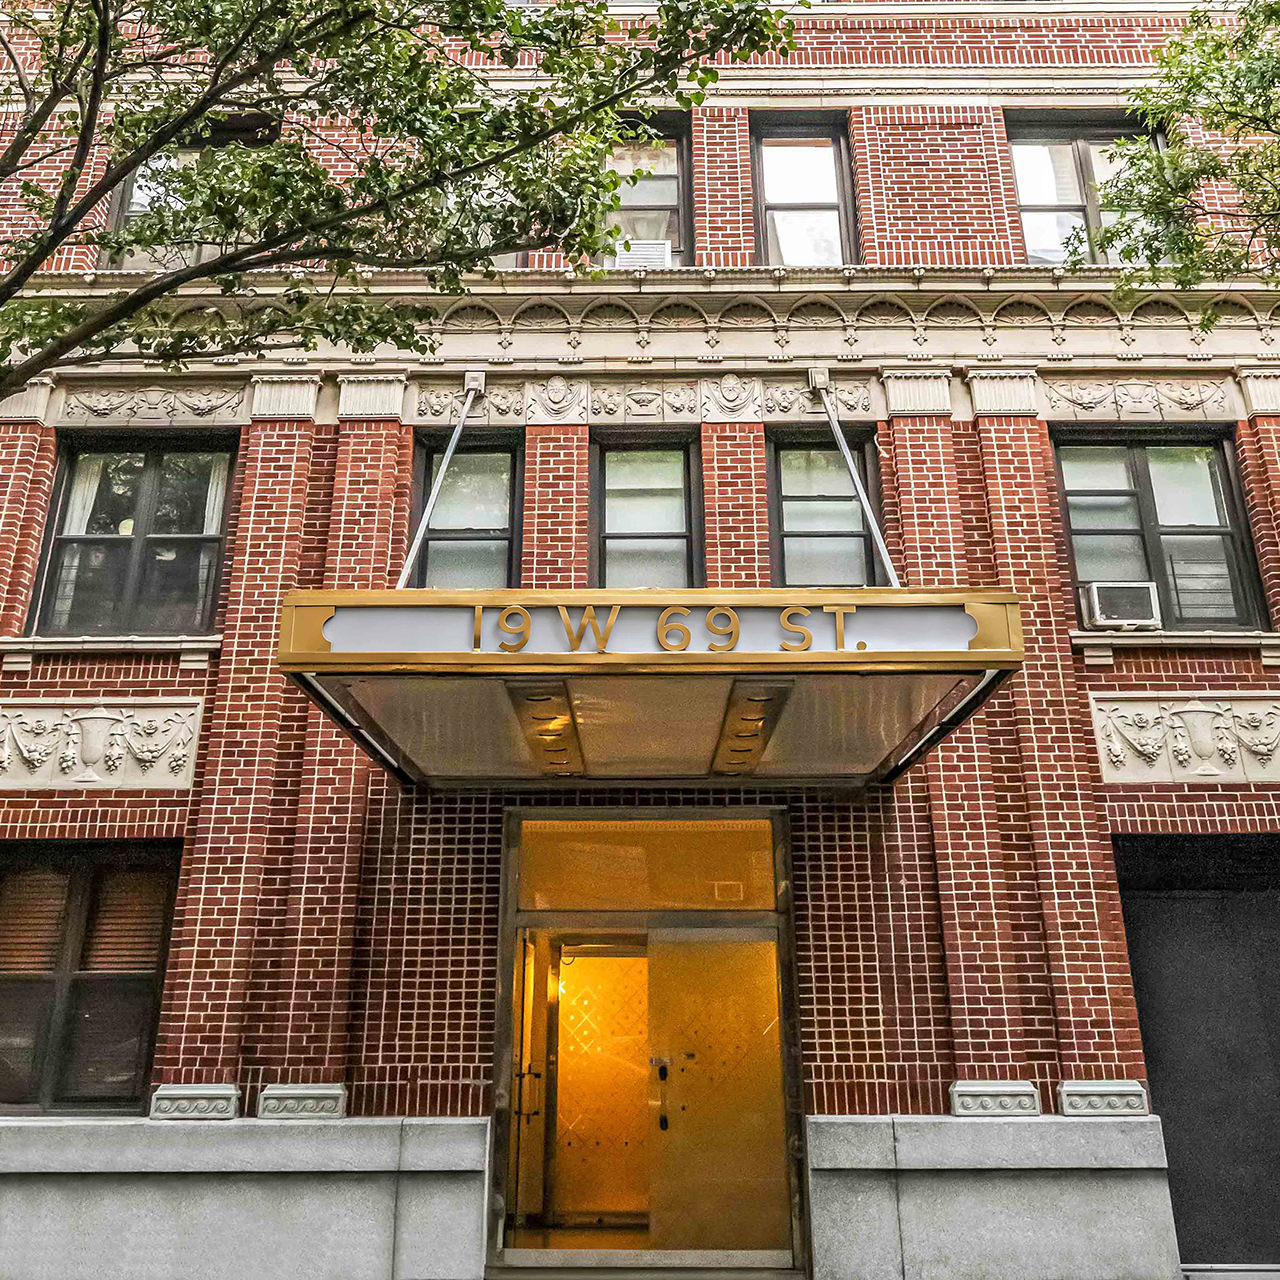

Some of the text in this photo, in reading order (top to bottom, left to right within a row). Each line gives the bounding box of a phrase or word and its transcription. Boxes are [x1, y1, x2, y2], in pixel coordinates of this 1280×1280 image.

[473, 605, 867, 652] 19 W 69 ST.
